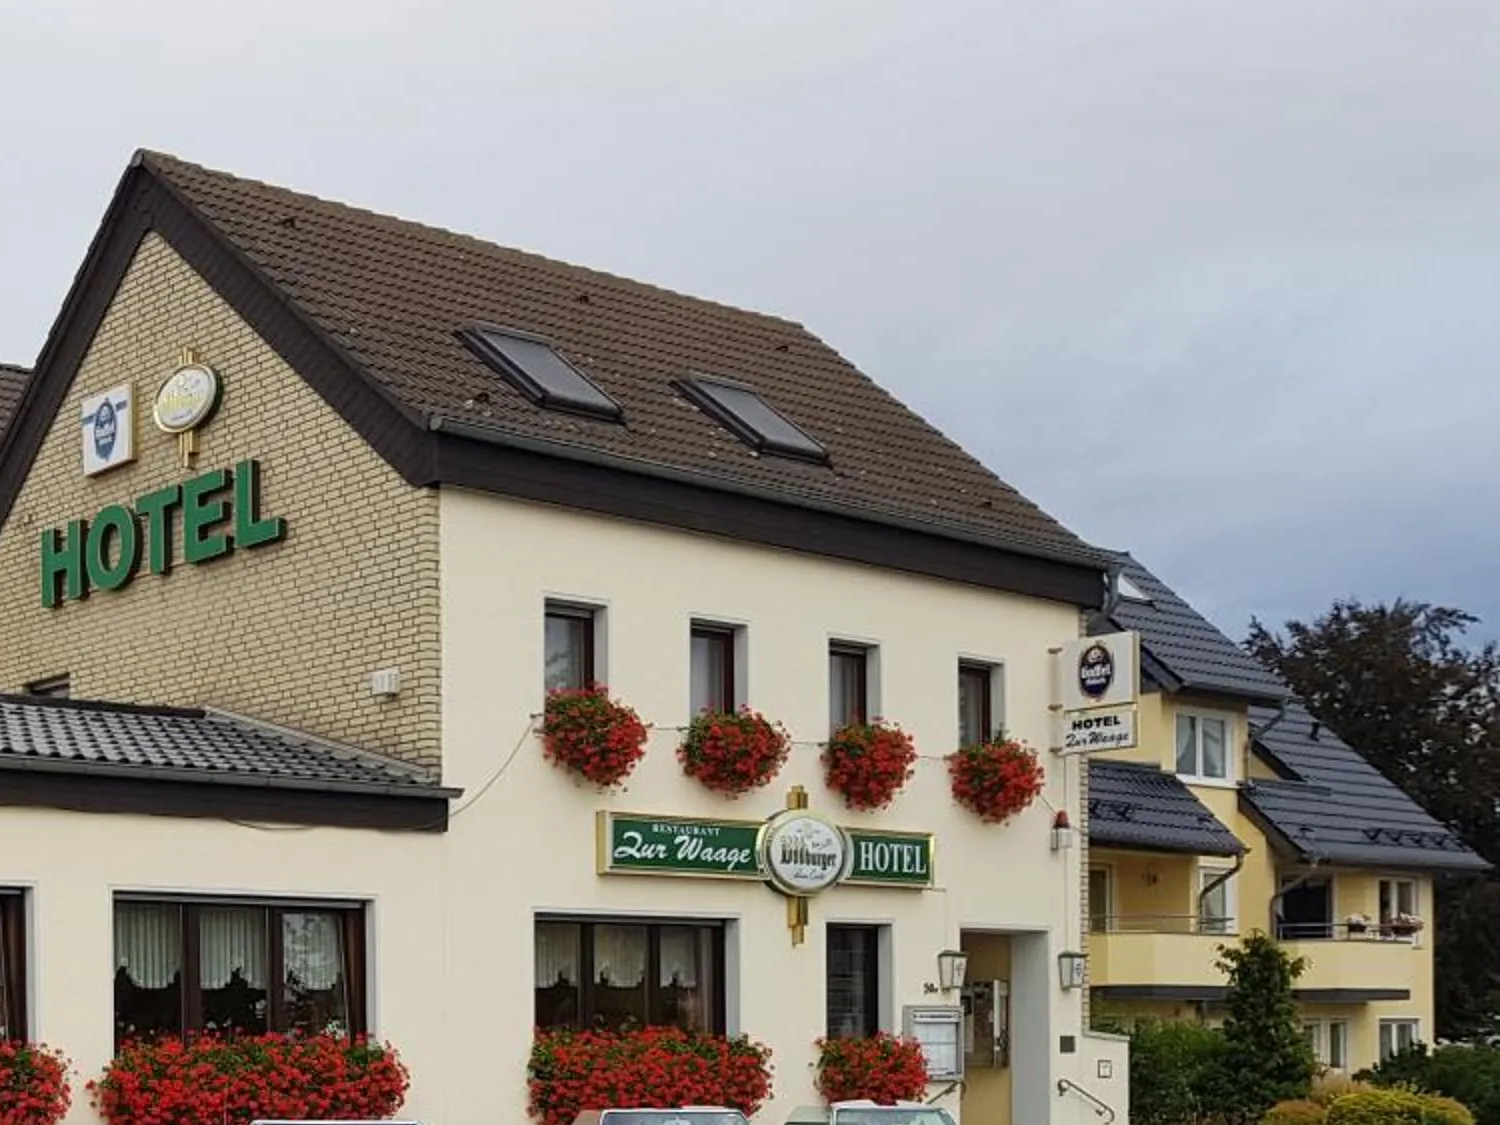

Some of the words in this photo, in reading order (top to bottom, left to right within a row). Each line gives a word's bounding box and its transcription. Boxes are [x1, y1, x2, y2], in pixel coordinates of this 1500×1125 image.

[41, 459, 284, 608] HOTEL
[1071, 715, 1121, 731] HOTEL
[651, 823, 721, 837] RESTAURANT
[613, 831, 668, 859] Zur
[673, 834, 751, 871] Waage
[859, 841, 927, 873] HOTEL
